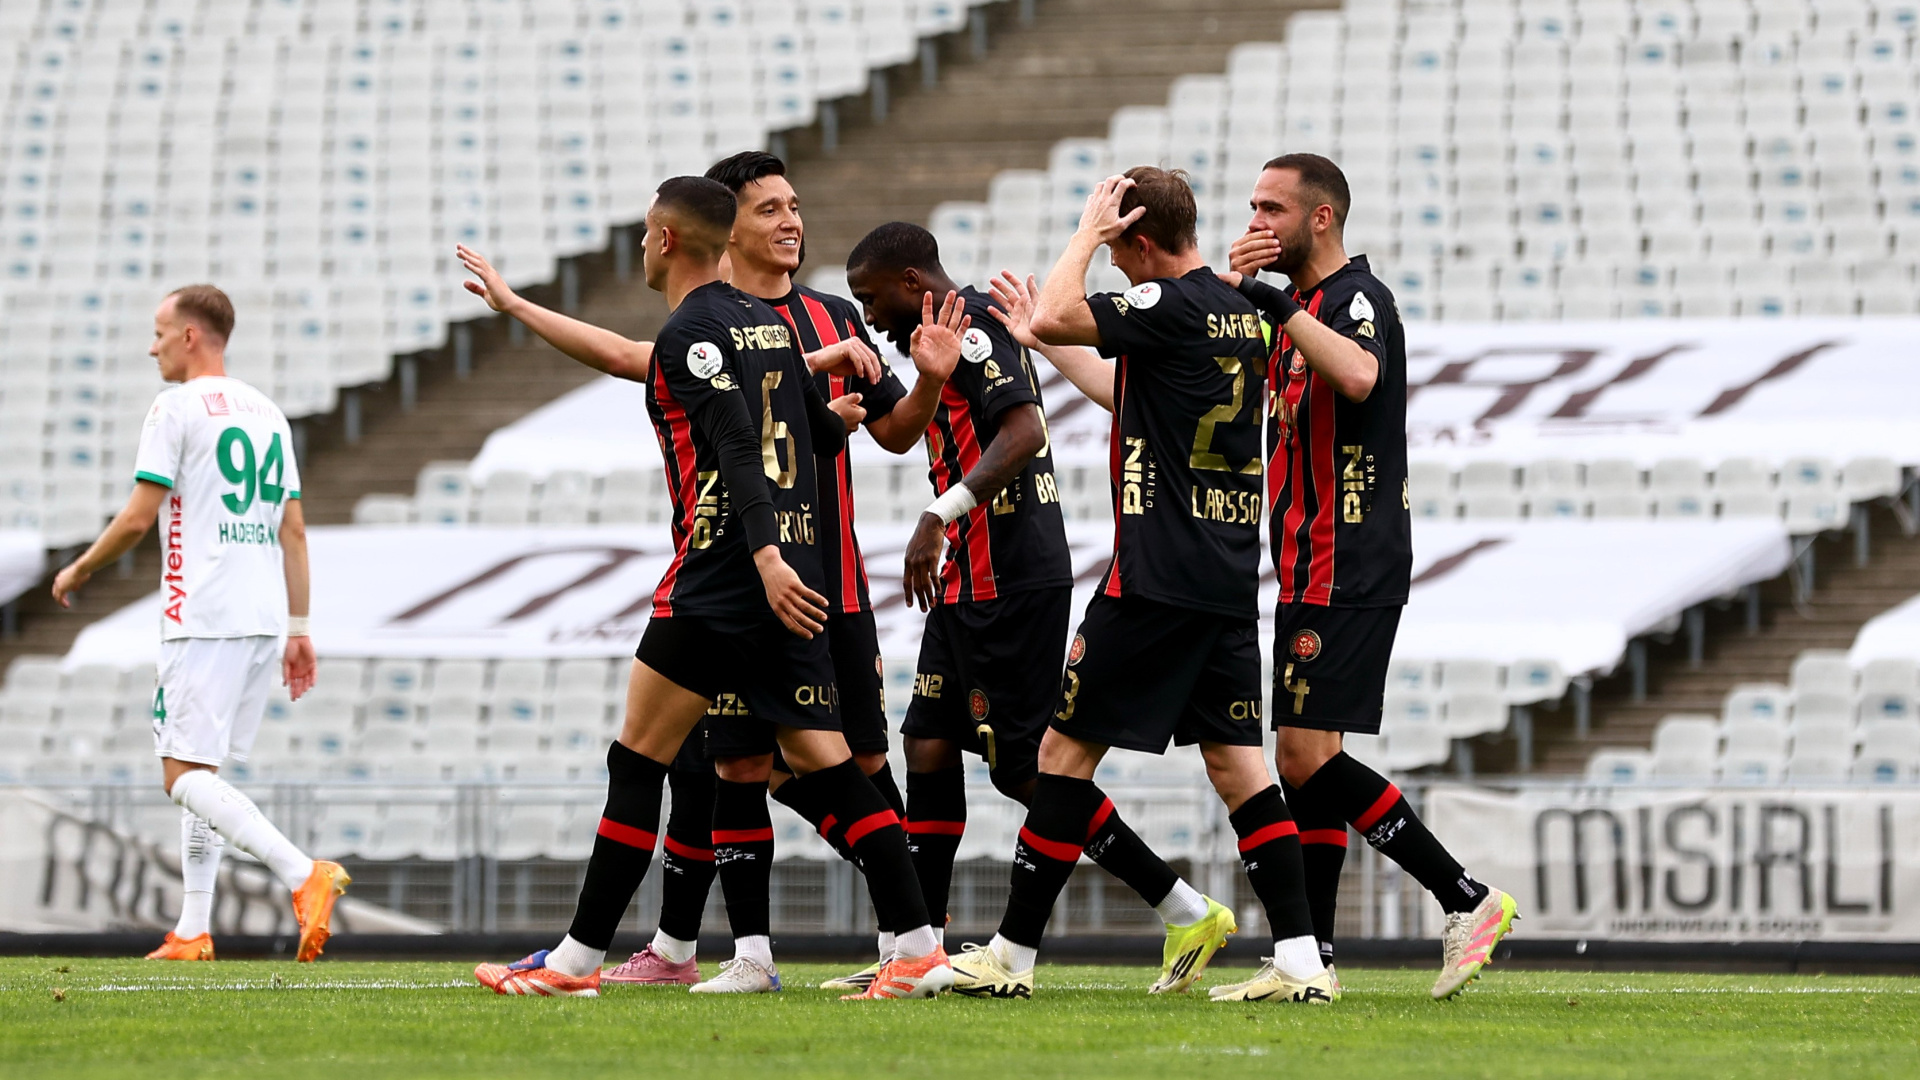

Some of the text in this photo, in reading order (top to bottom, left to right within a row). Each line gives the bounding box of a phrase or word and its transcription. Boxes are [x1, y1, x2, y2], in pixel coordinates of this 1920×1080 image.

[216, 426, 285, 516] 94
[761, 371, 797, 489] 6
[164, 496, 187, 626] Aytemiz
[1284, 663, 1310, 714] 4
[1534, 805, 1894, 914] MISIRLI
